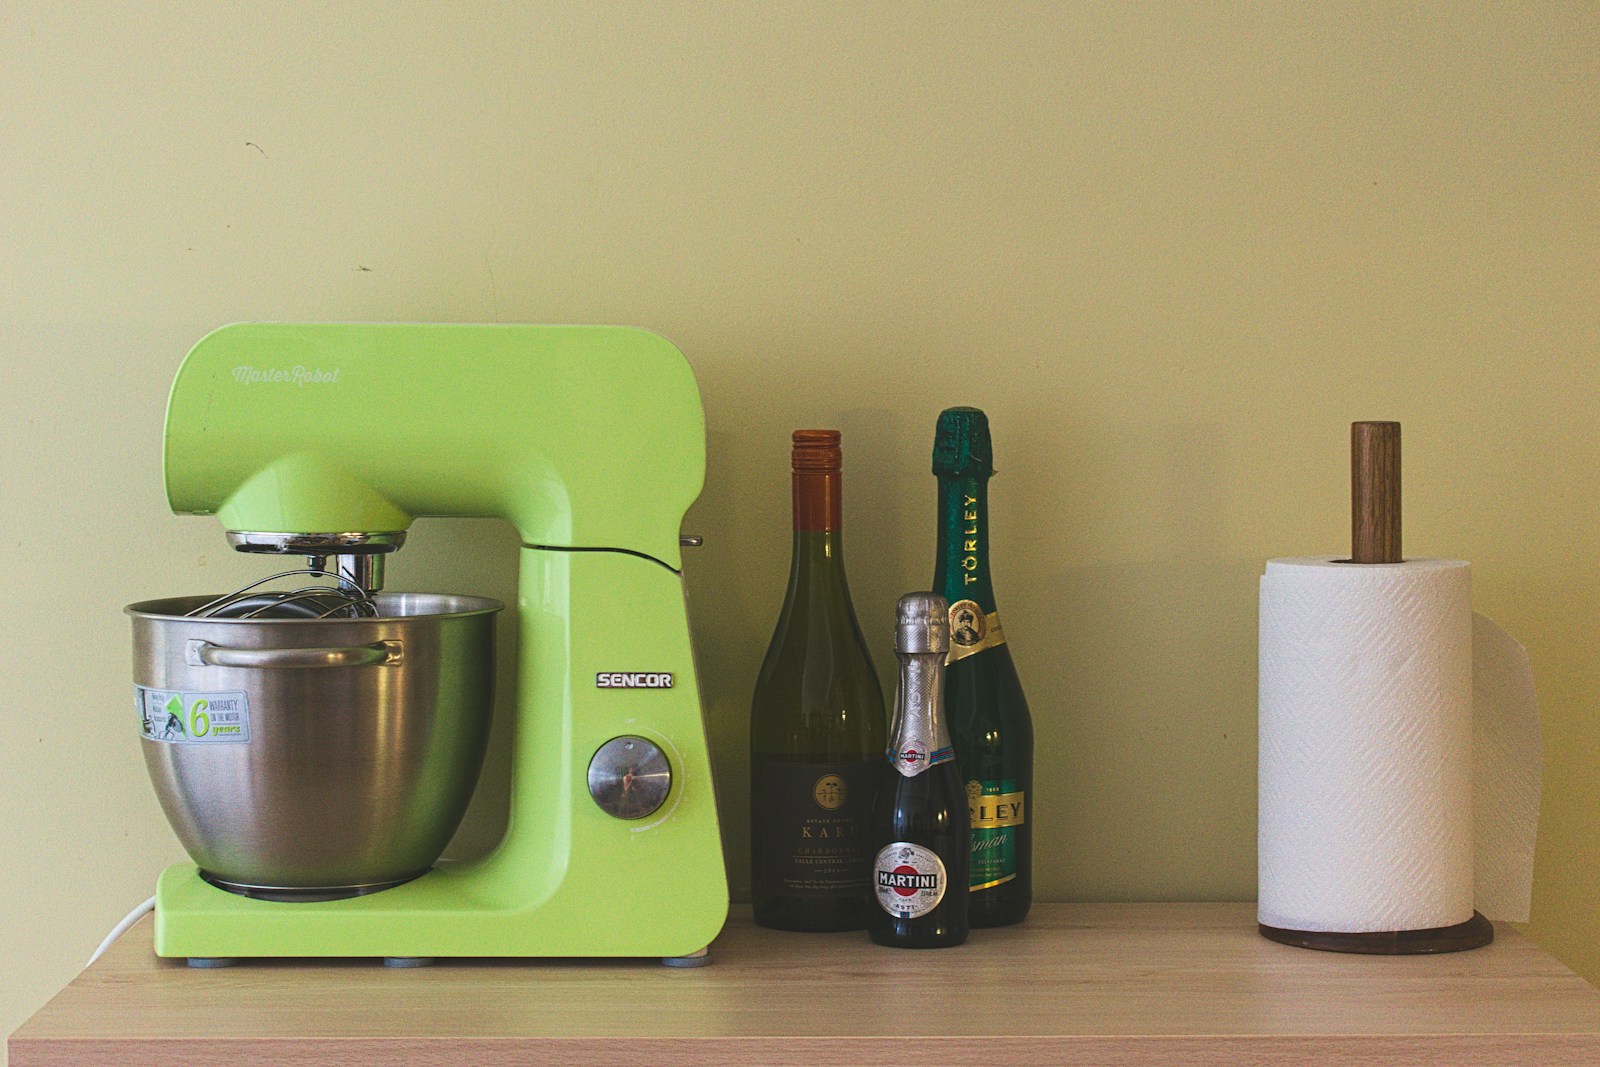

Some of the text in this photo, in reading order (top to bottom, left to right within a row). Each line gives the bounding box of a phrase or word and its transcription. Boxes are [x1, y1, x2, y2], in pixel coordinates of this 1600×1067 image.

[961, 494, 977, 585] TÖRLEY
[597, 674, 672, 687] SENCOR
[209, 700, 238, 711] WARRANTY
[189, 698, 209, 737] 6
[212, 726, 241, 737] years
[970, 802, 1021, 821] LEY
[970, 833, 1008, 853] sman
[879, 872, 935, 888] MARTINI
